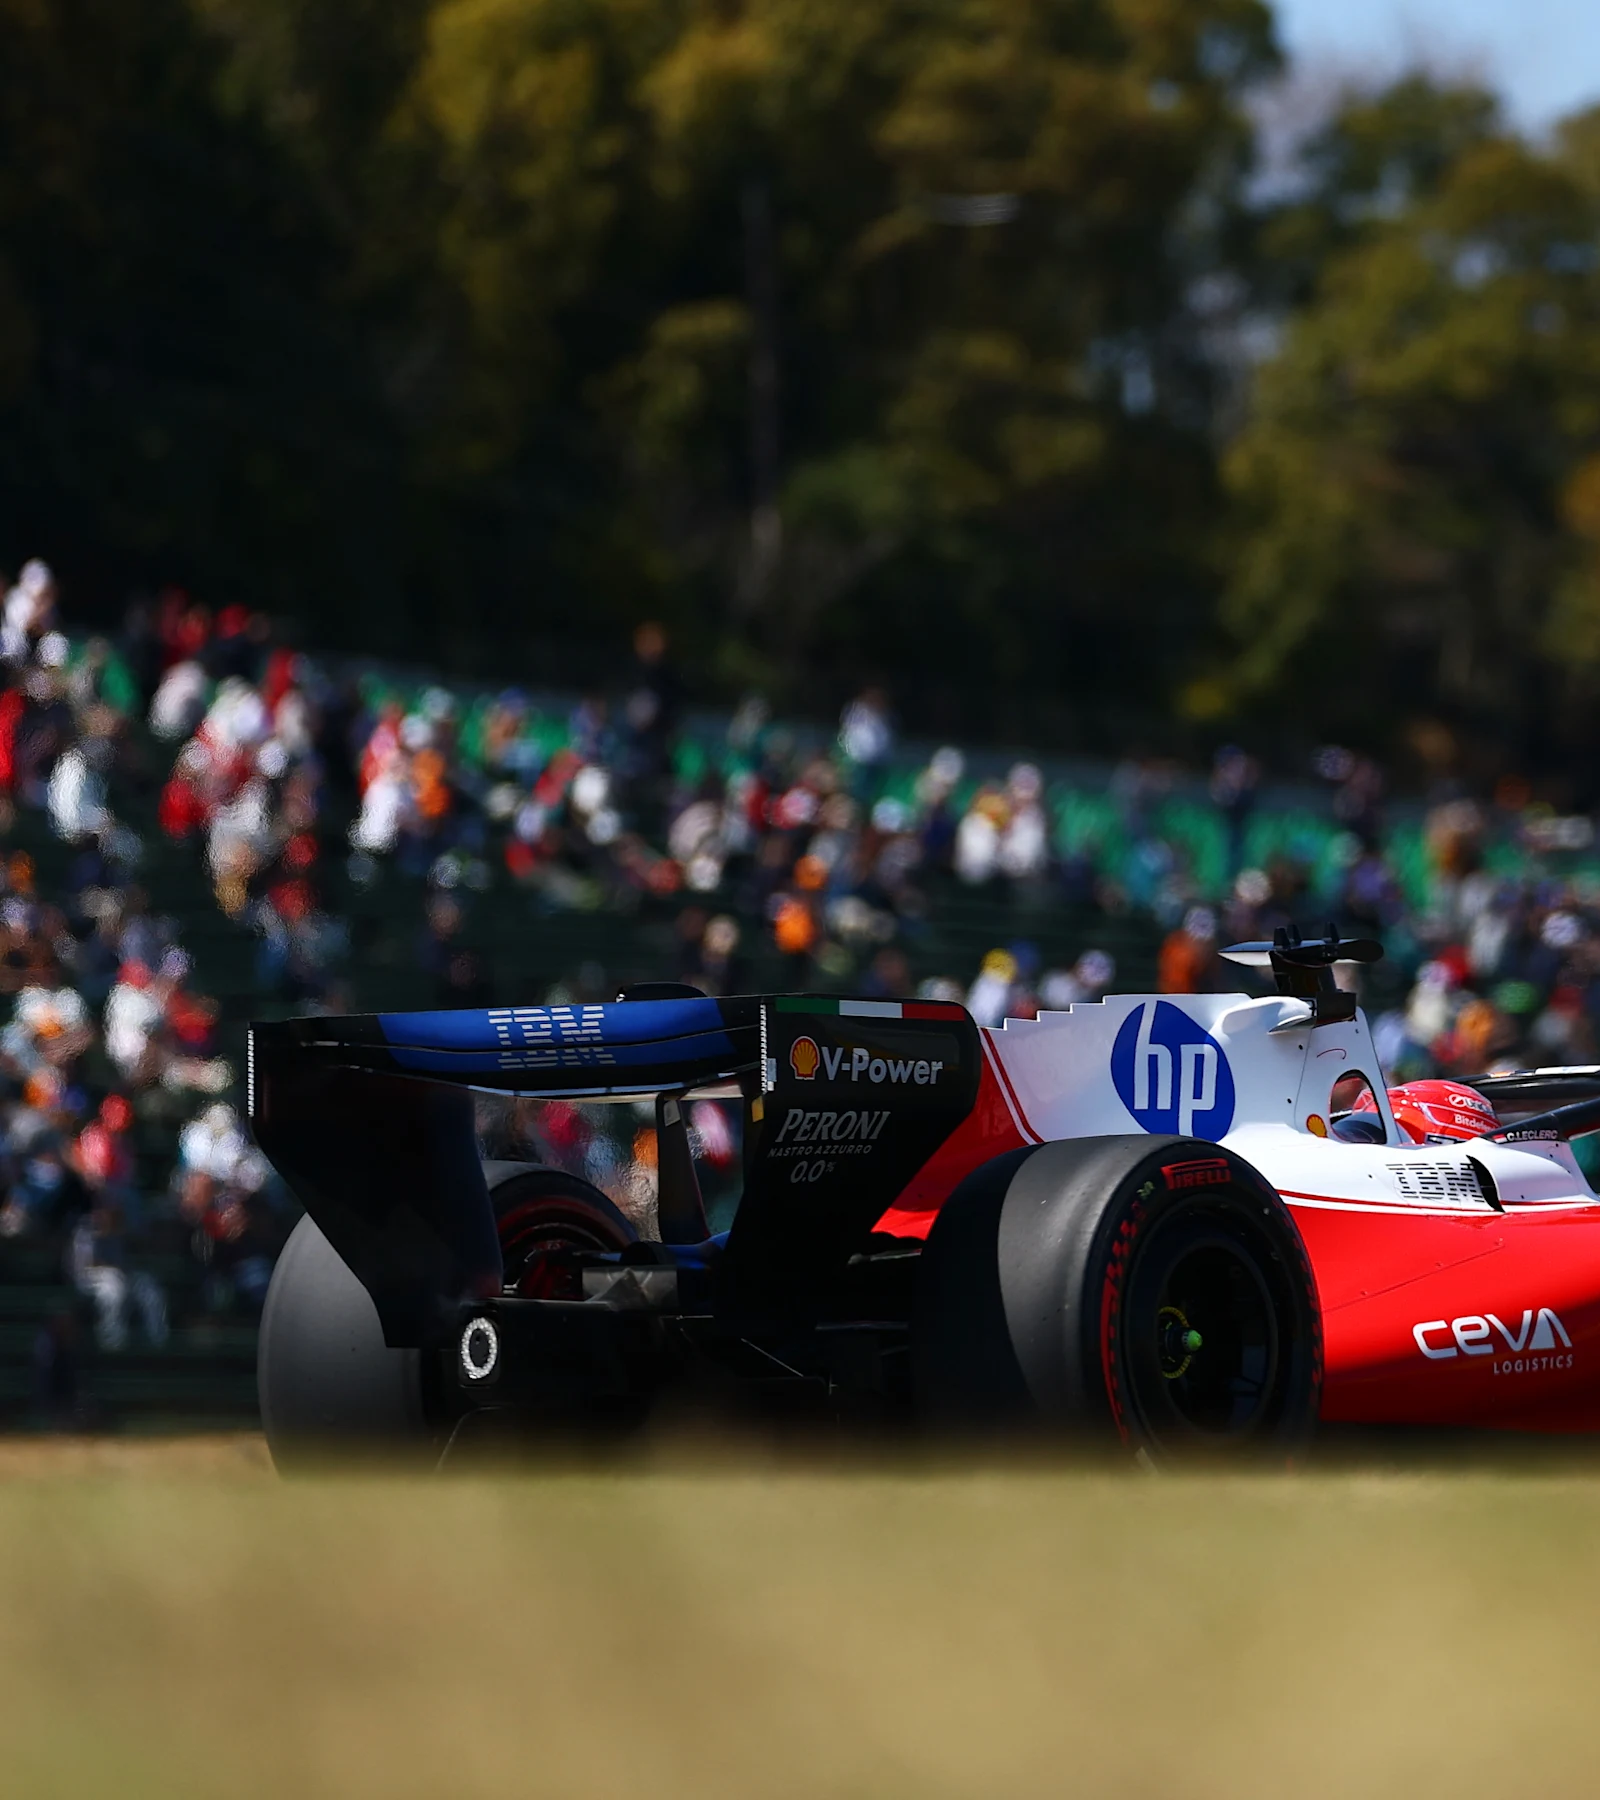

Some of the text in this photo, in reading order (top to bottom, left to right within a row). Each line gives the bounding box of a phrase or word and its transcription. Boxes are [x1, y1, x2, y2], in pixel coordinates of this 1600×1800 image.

[488, 1006, 616, 1069] IBM
[821, 1046, 944, 1085] V-Power
[1133, 1000, 1219, 1137] hp
[774, 1109, 891, 1143] PERONI
[767, 1144, 873, 1159] NASTRO AZZURRO
[1160, 1157, 1232, 1190] PIRELLI
[1493, 1354, 1574, 1375] LOGISTICS
